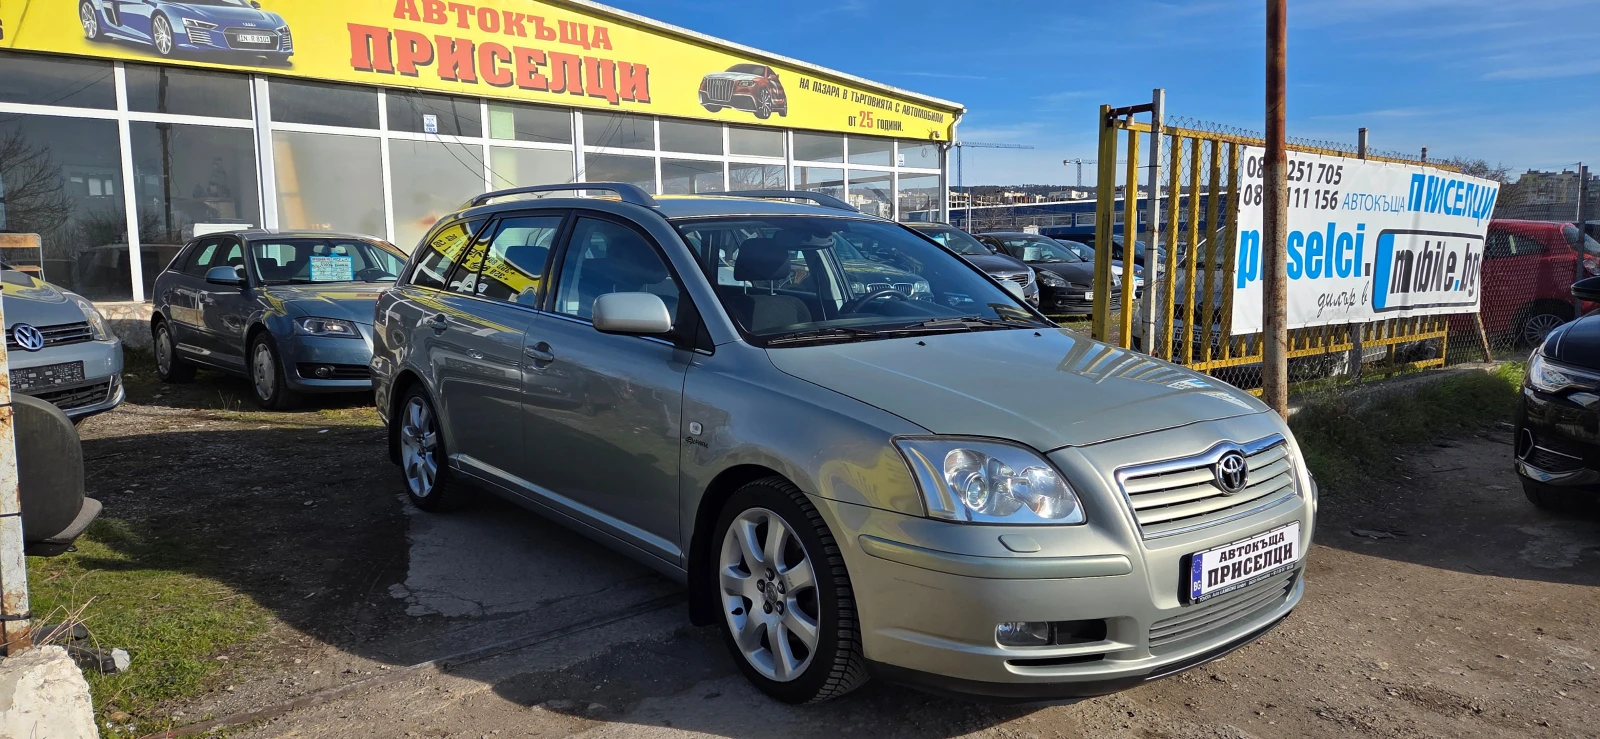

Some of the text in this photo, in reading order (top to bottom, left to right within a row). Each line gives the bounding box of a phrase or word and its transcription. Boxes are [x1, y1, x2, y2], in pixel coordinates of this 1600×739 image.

[393, 0, 613, 50] АВТОКЪЩА
[347, 22, 651, 105] ПРИСЕЛЦИ
[799, 77, 944, 124] НА ПАЗАРА В ТЪРГОВИЯТА С АВТОМОБИЛИ
[848, 111, 904, 132] ОТ 25 ГОДИНИ.
[1287, 160, 1313, 183] 251
[1317, 162, 1343, 186] 705
[1286, 186, 1309, 209] 111
[1314, 189, 1338, 211] 156
[1341, 173, 1498, 227] АВТОКЪЩА ПРИСЕЛЦИ
[1236, 222, 1371, 289] pselci.
[1317, 290, 1357, 319] дилър
[1207, 541, 1293, 588] ПРИСЕЛЦИ
[1218, 531, 1285, 563] АВТОКЪЩА
[1193, 580, 1202, 592] BG
